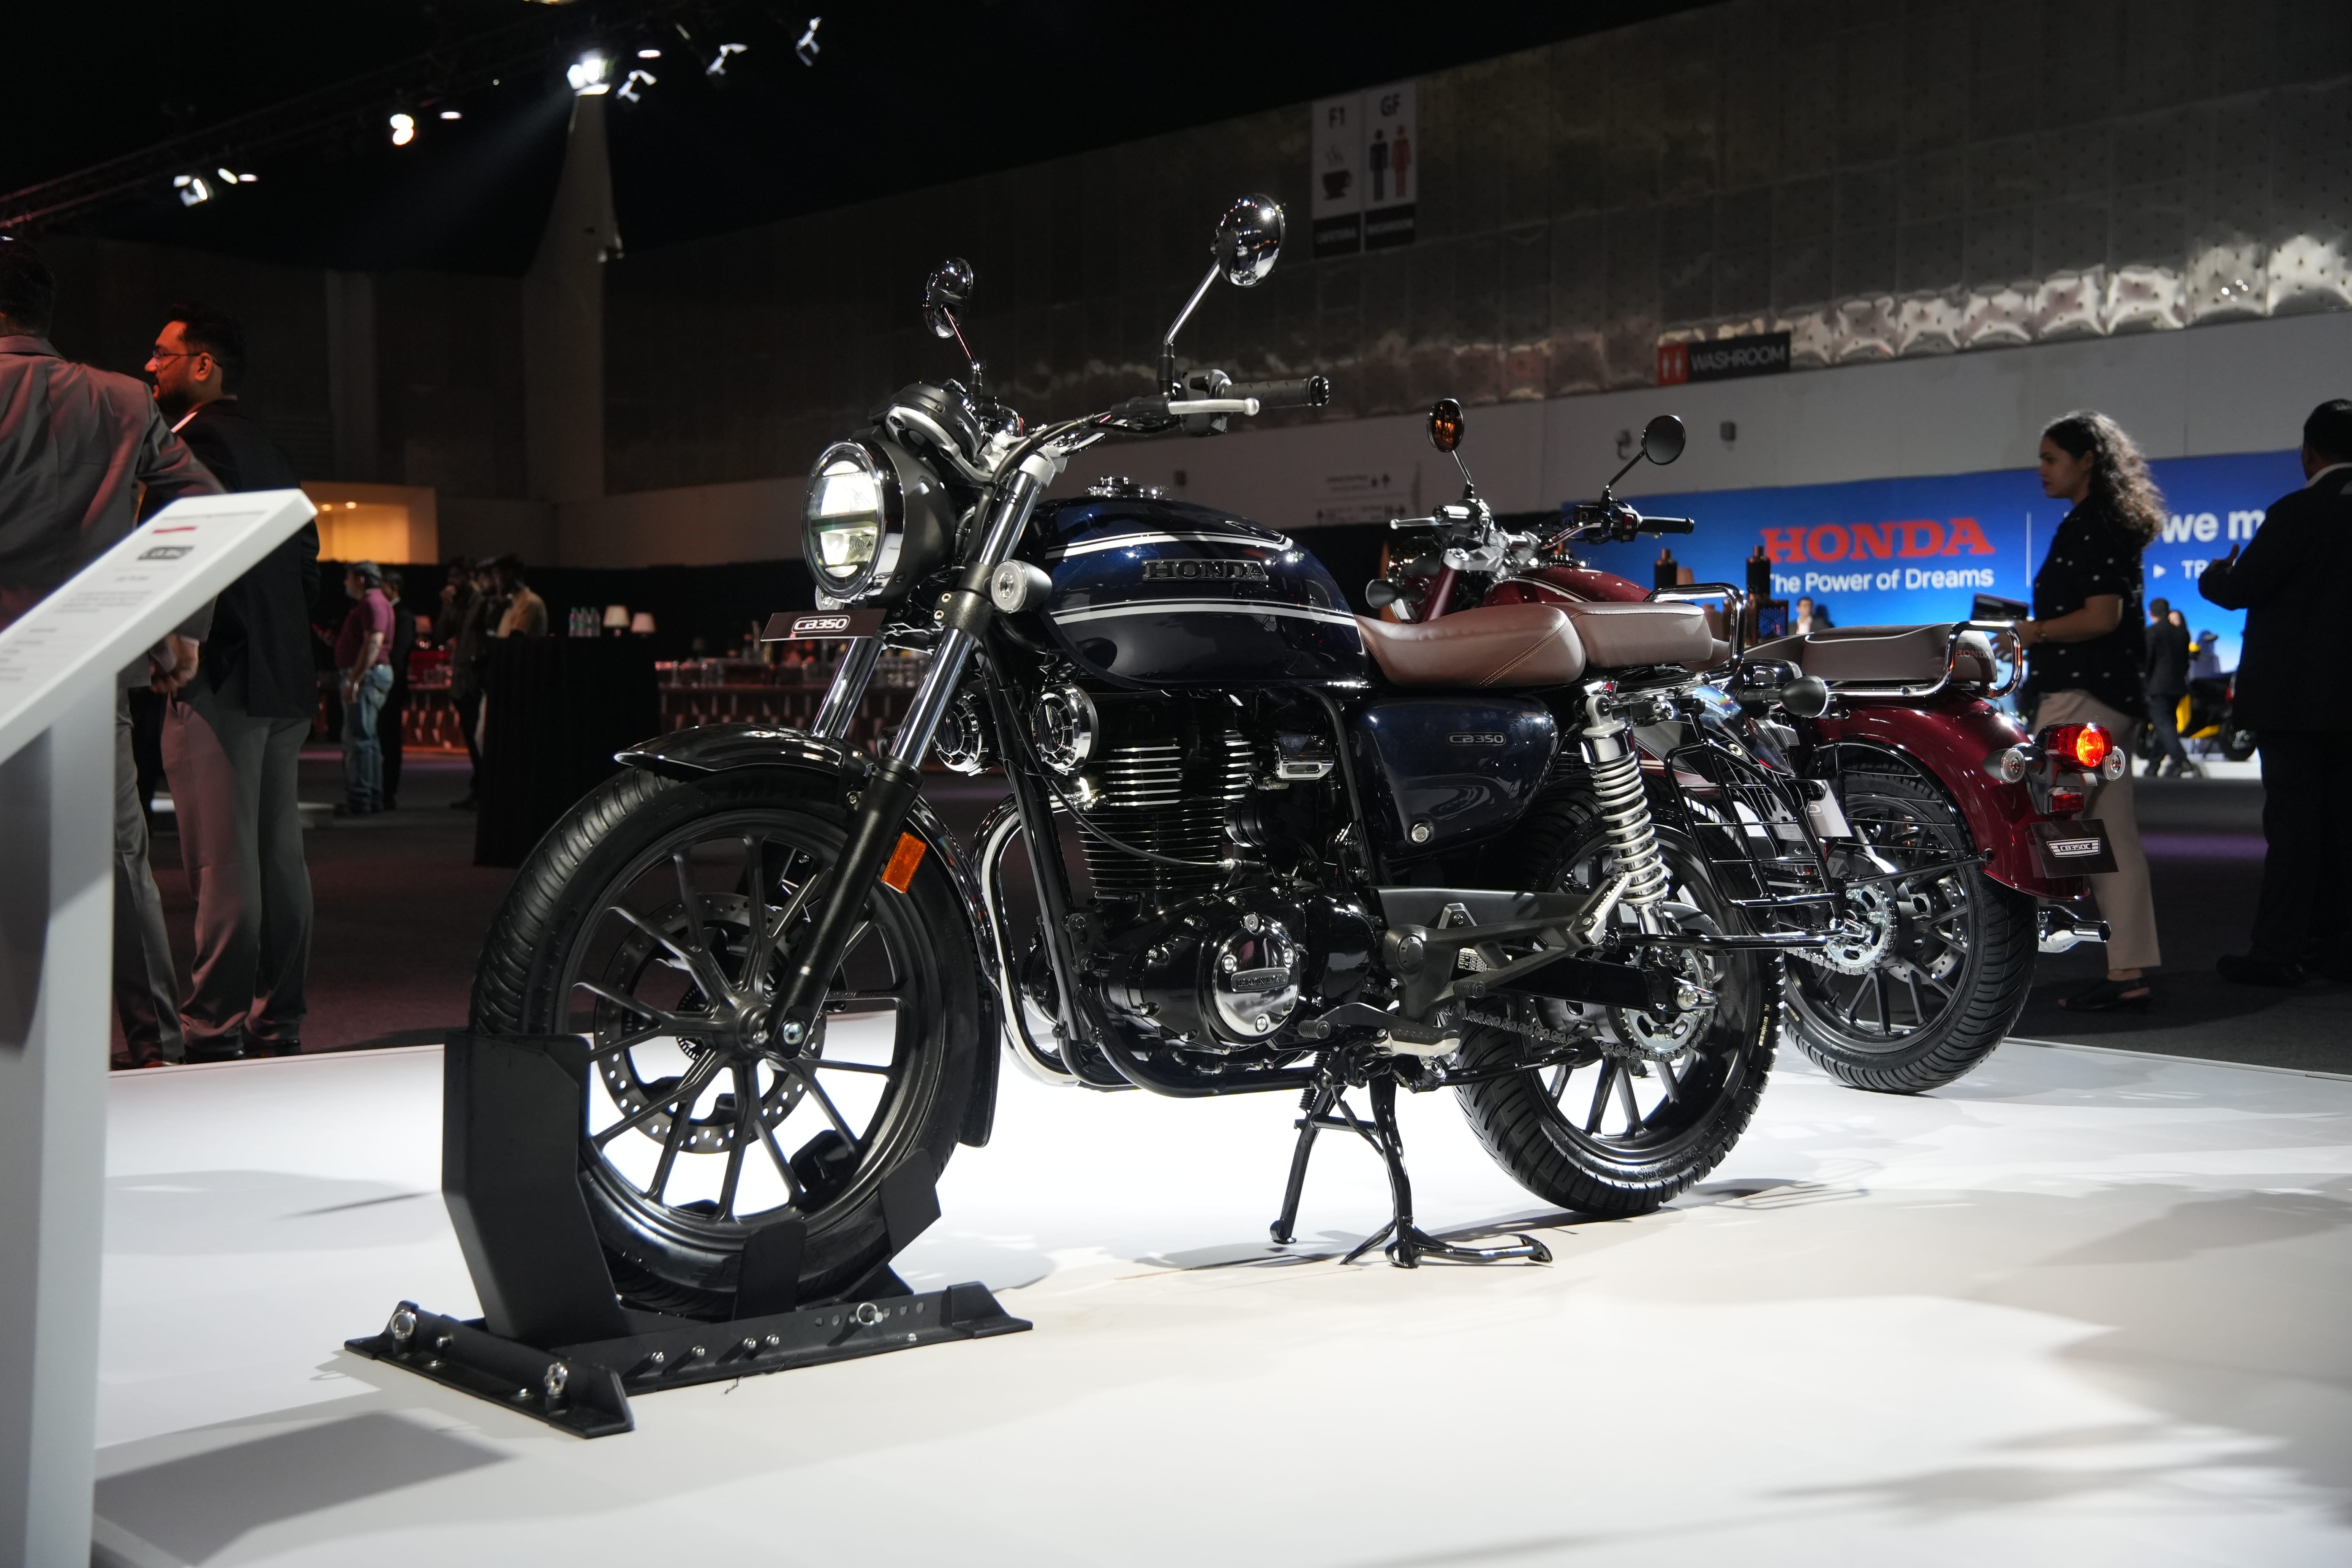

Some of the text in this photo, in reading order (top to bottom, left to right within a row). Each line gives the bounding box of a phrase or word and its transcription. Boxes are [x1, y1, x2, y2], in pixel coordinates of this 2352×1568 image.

[1690, 345, 1785, 371] WASHROOM
[2160, 512, 2219, 544] we
[1760, 517, 1996, 564] HONDA
[1141, 559, 1269, 582] HONDA
[1805, 571, 1870, 592] Power
[1876, 568, 1902, 591] of
[1905, 567, 1995, 590] Dreams
[793, 618, 847, 631] CB350
[1955, 650, 1992, 659] HONDA
[1449, 735, 1504, 743] CB350
[2060, 843, 2092, 852] CB350C
[1238, 974, 1286, 988] HONDA
